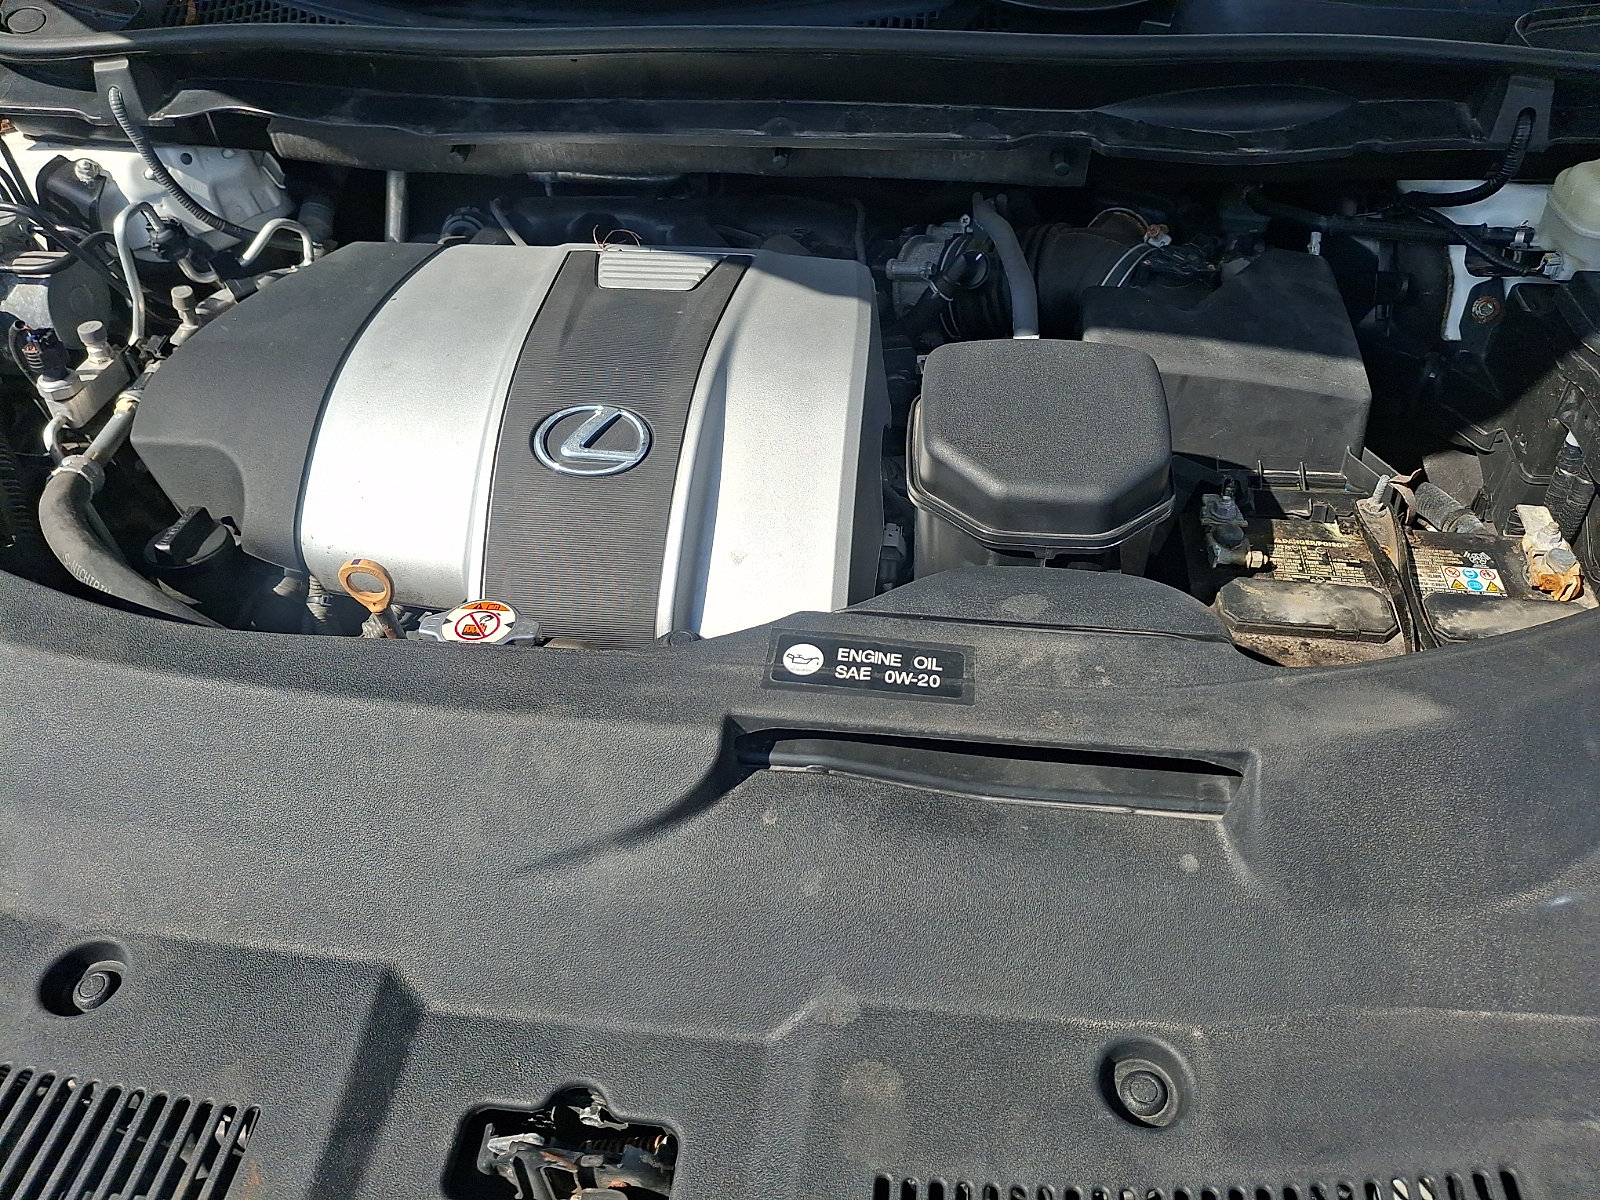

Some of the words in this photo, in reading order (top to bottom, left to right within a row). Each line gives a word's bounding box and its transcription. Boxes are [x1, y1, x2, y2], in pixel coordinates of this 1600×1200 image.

[837, 648, 902, 667] ENGINE
[913, 656, 943, 671] OIL
[835, 665, 872, 681] SAE
[884, 670, 941, 688] 0W-20
